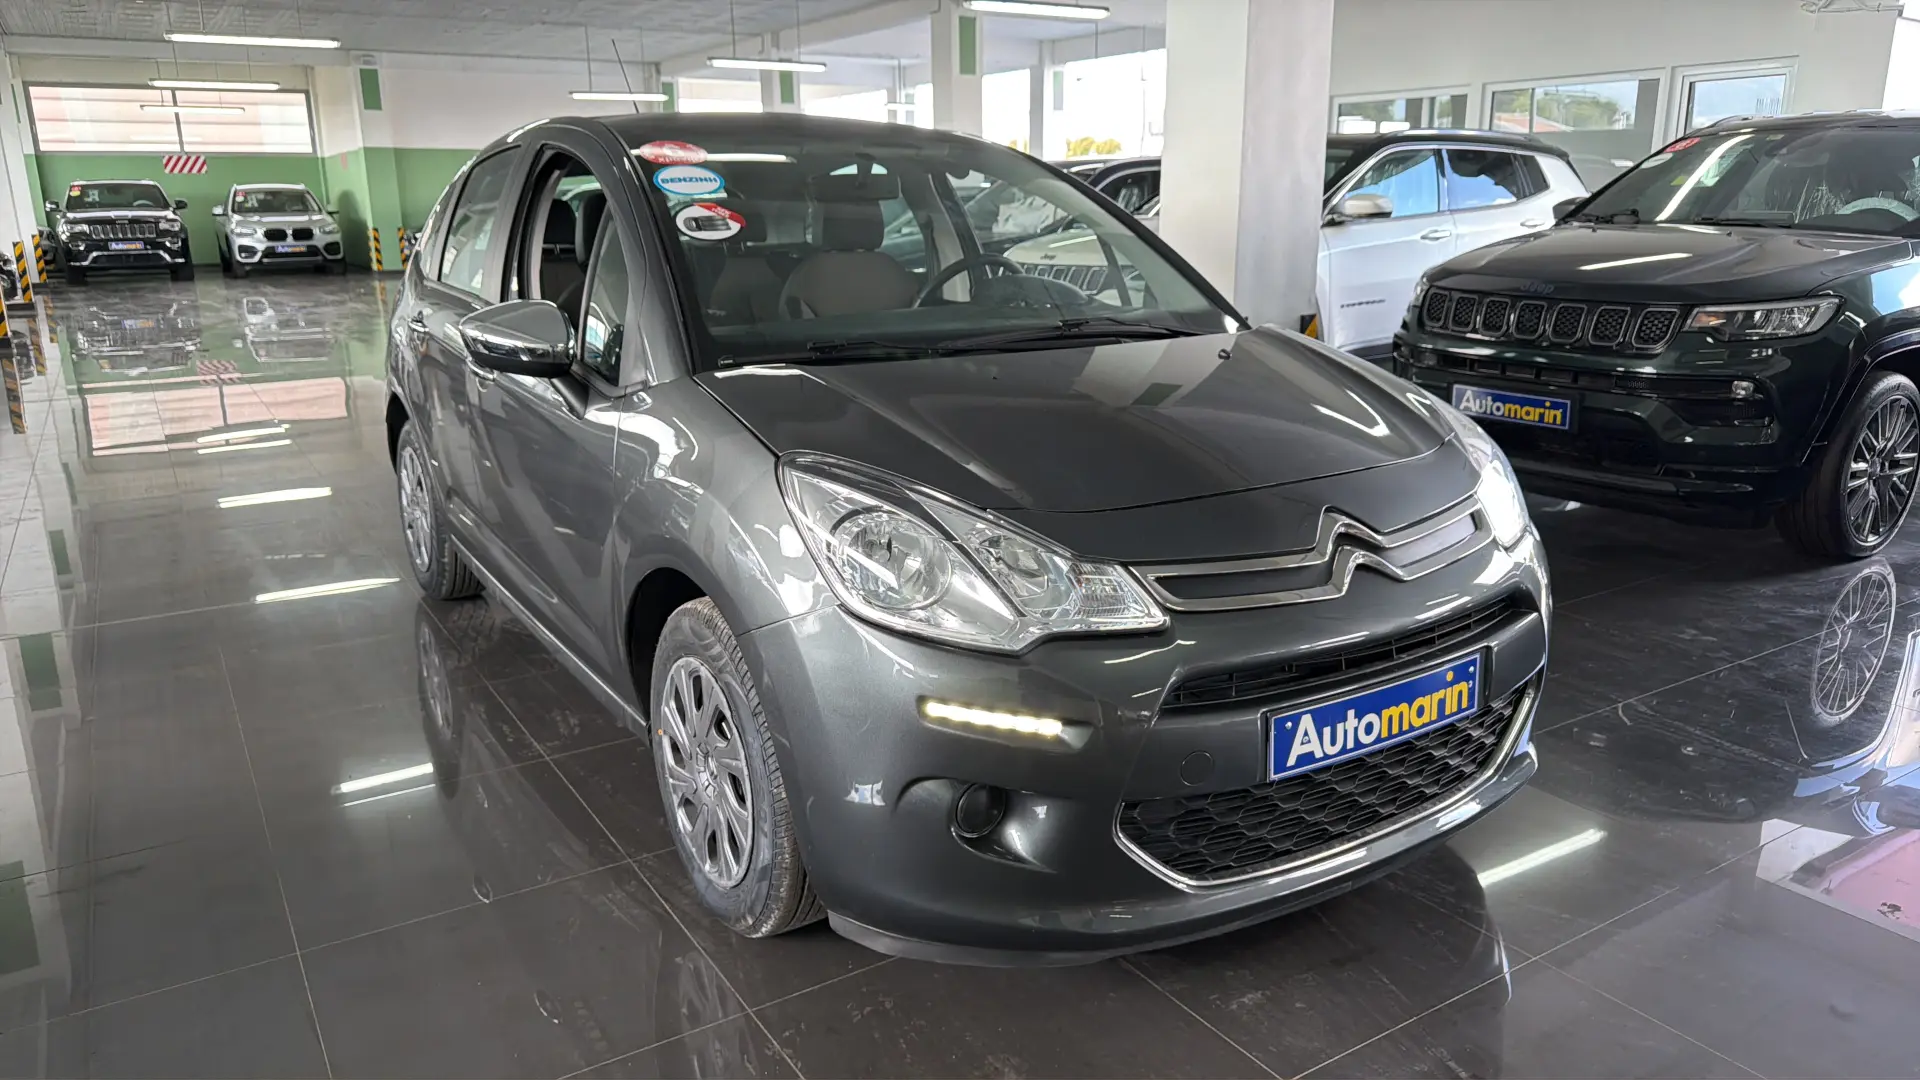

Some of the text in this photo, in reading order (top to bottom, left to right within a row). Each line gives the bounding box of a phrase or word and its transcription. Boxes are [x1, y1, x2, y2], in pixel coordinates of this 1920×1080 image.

[1520, 281, 1555, 296] Jeep
[1459, 389, 1563, 425] Automarin
[1286, 670, 1469, 767] Automarin
